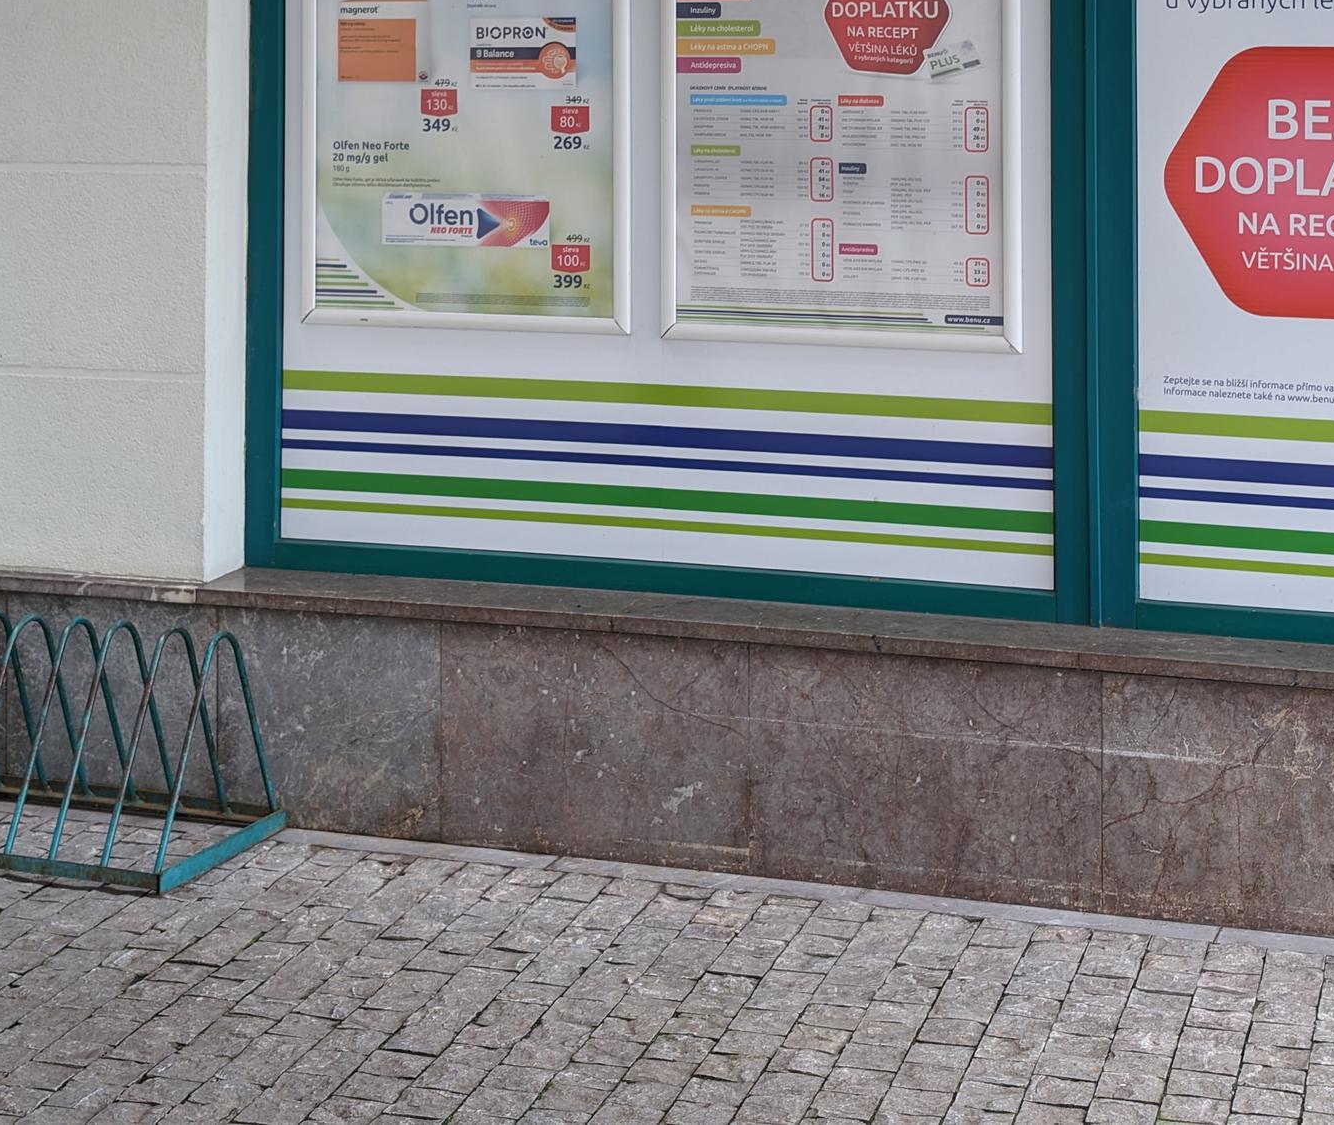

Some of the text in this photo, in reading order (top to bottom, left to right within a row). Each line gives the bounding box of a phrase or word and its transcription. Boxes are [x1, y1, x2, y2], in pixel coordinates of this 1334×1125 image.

[831, 1, 939, 19] DOPLATKU
[476, 26, 546, 40] BIOPRON
[690, 24, 706, 33] Léky
[717, 24, 754, 32] cholesterol
[847, 26, 919, 39] NA RECEPT
[476, 49, 515, 58] 9 Balance
[848, 42, 917, 57] VĚTŠINA LÉKŮ
[690, 61, 737, 70] Antidepresiva
[930, 54, 961, 70] PLUS
[434, 78, 450, 87] 479
[426, 99, 448, 111] 130
[566, 95, 582, 104] 349
[422, 118, 450, 132] 349
[559, 117, 575, 128] 80
[332, 140, 410, 150] Olfen Neo Forte
[553, 136, 582, 150] 269
[332, 153, 389, 164] 20 mg/g gel
[409, 202, 474, 226] Olfen
[1238, 212, 1280, 236] NA
[430, 226, 474, 235] NEO FORTE
[529, 238, 548, 247] teva
[566, 234, 582, 243] 499
[557, 255, 579, 267] 100
[1241, 245, 1334, 273] VĚTŠINA
[553, 275, 582, 289] 399
[1163, 376, 1200, 387] Zeptejte
[1226, 378, 1248, 388] bližší
[1250, 379, 1294, 390] informace
[1296, 381, 1322, 394] přímo
[1163, 387, 1207, 397] Informace
[1209, 390, 1252, 400] naleznete
[1254, 392, 1273, 401] také
